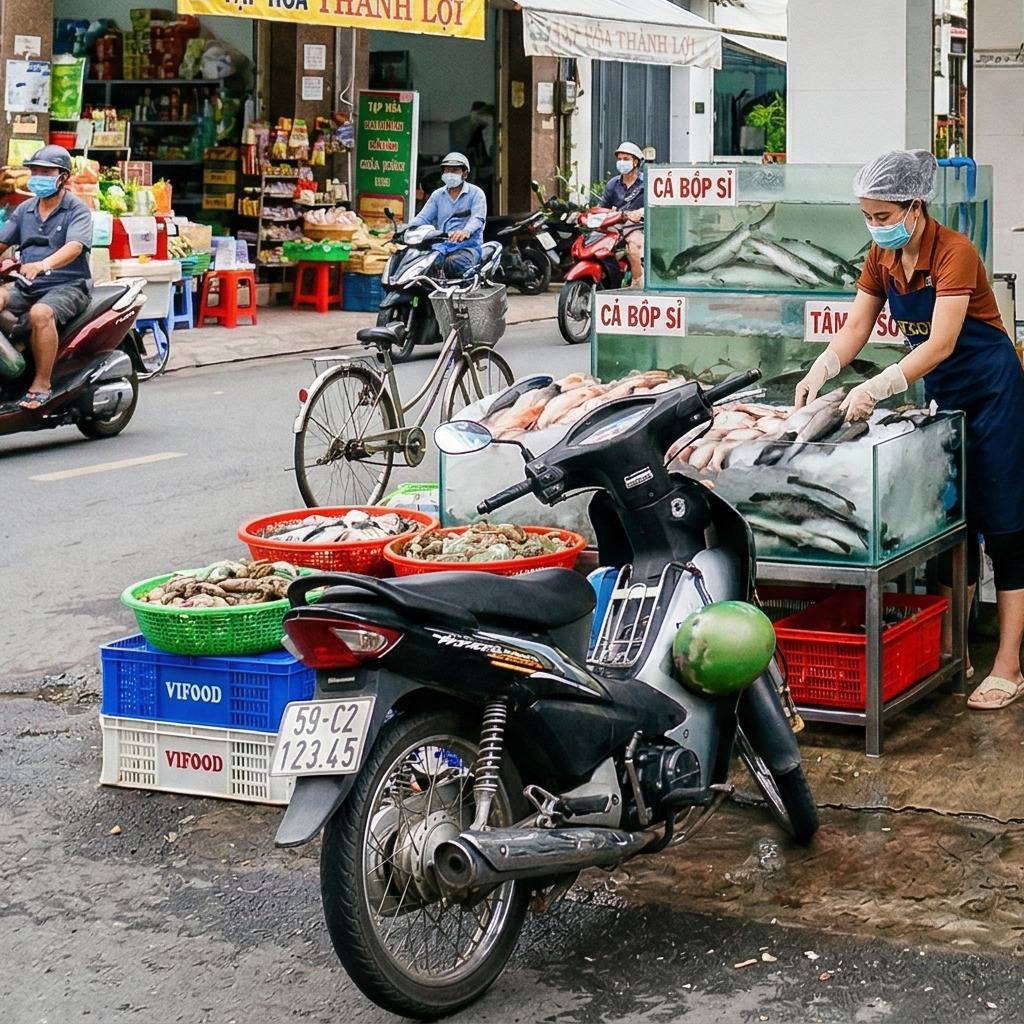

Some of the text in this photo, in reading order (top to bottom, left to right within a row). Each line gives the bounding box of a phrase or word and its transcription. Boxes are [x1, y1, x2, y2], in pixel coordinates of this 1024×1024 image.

[679, 170, 712, 203] BỘP
[627, 298, 661, 332] BỘP
[666, 299, 682, 329] SỈ
[164, 681, 222, 704] VIFOOD
[293, 703, 359, 736] 59-C2
[164, 749, 224, 773] VIFOOD
[281, 737, 358, 771] 123.45
